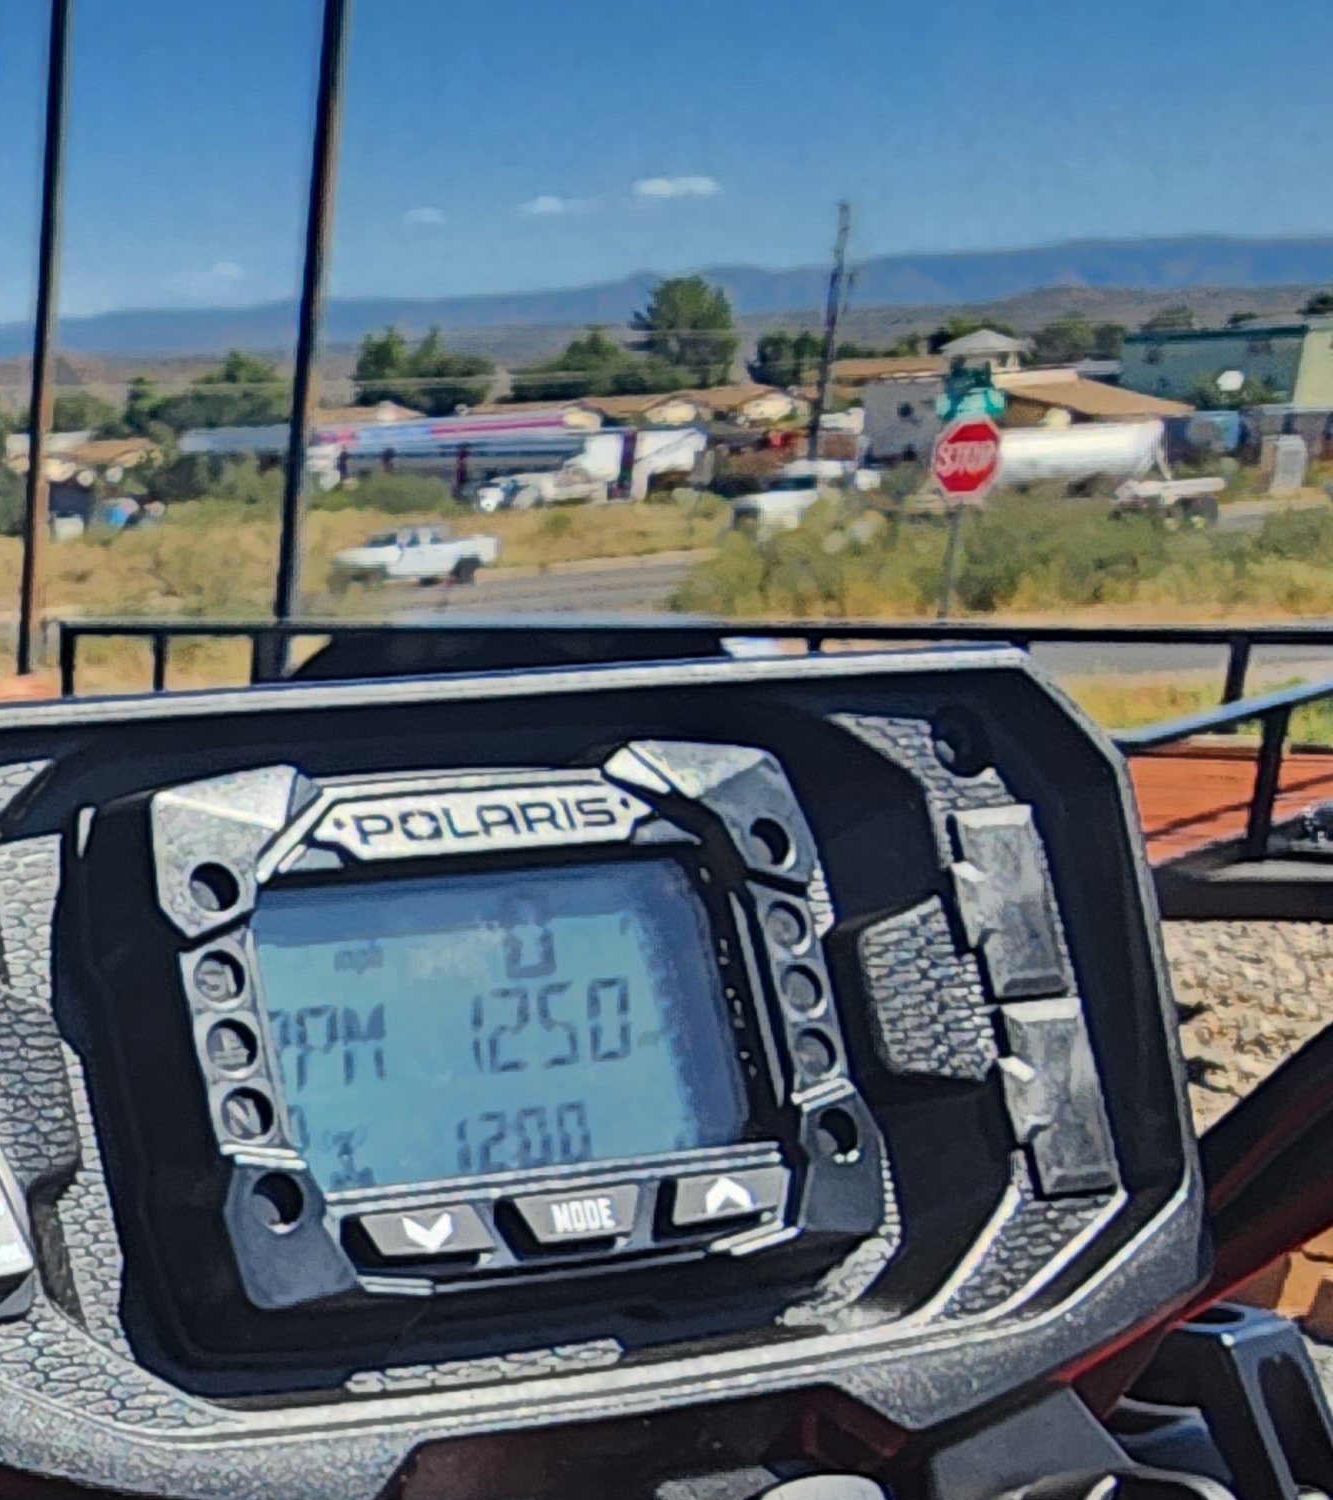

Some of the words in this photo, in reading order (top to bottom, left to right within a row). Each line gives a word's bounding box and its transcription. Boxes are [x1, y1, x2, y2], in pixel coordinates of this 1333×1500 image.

[351, 797, 617, 845] POLARIS
[470, 977, 631, 1074] 1250
[457, 1101, 593, 1173] 1200
[551, 1198, 616, 1233] MODE
